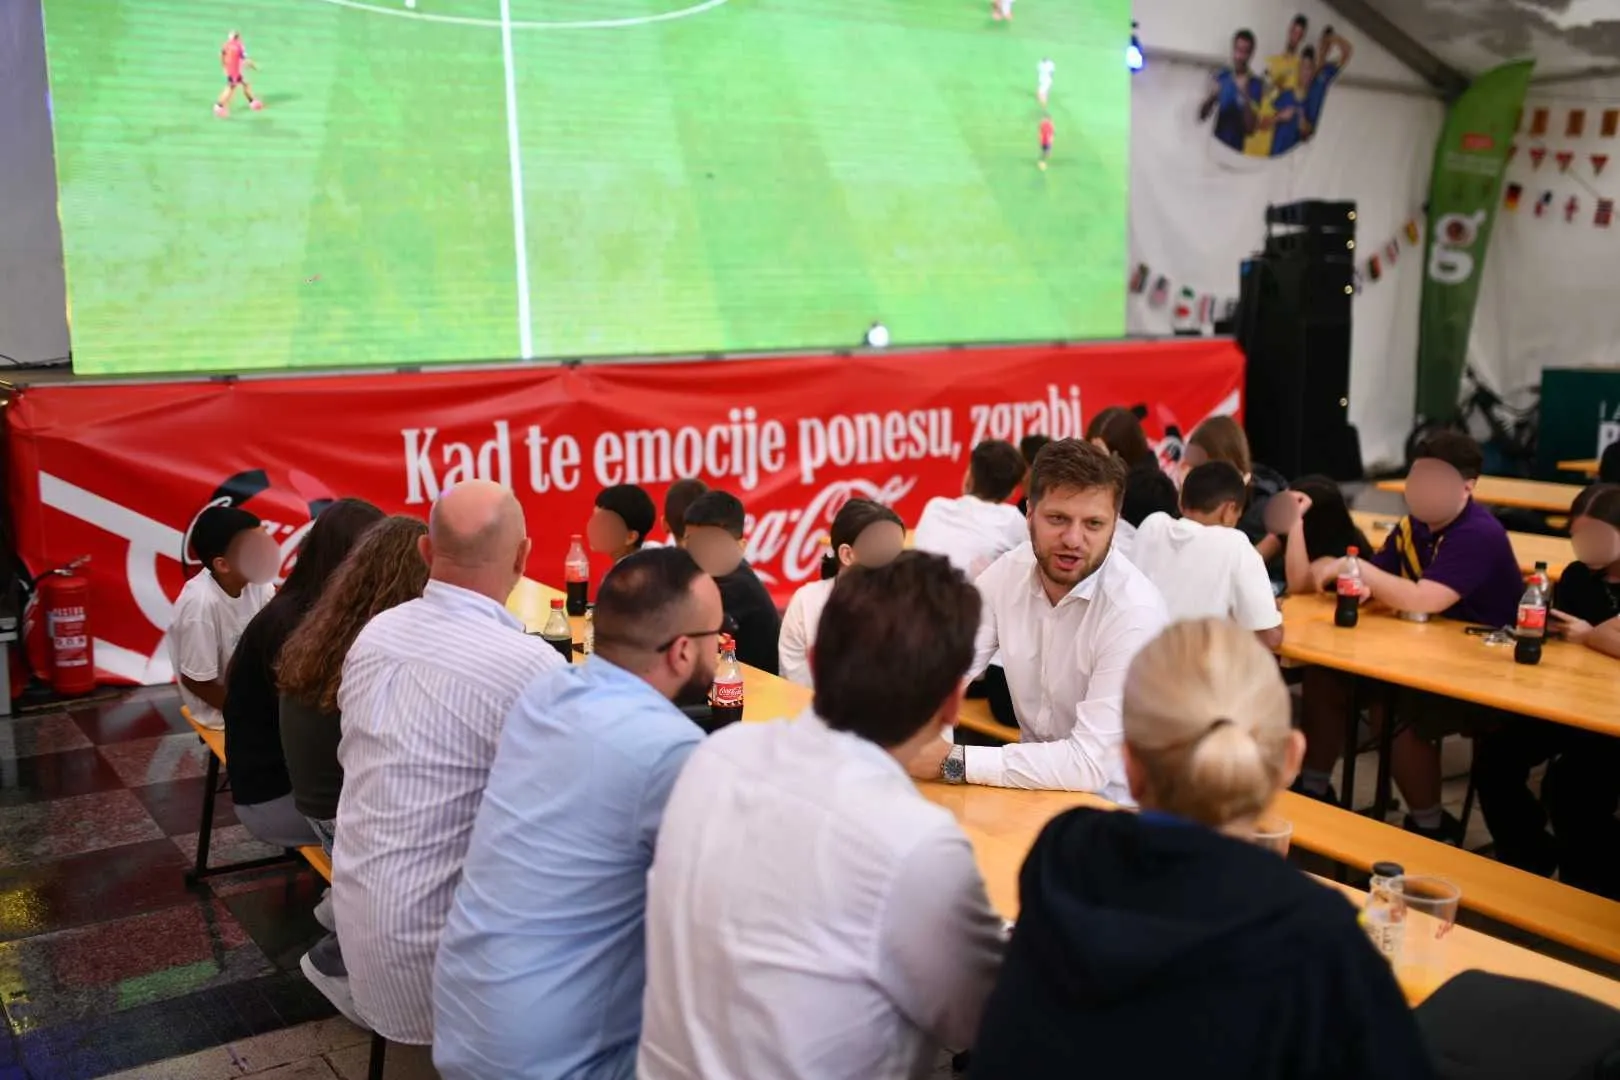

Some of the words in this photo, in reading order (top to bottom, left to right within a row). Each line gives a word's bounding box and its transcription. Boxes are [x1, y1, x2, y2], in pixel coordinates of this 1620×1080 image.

[401, 420, 513, 504] Kad
[525, 425, 581, 493] te
[593, 407, 786, 490] emocije
[798, 405, 962, 484] ponesu,
